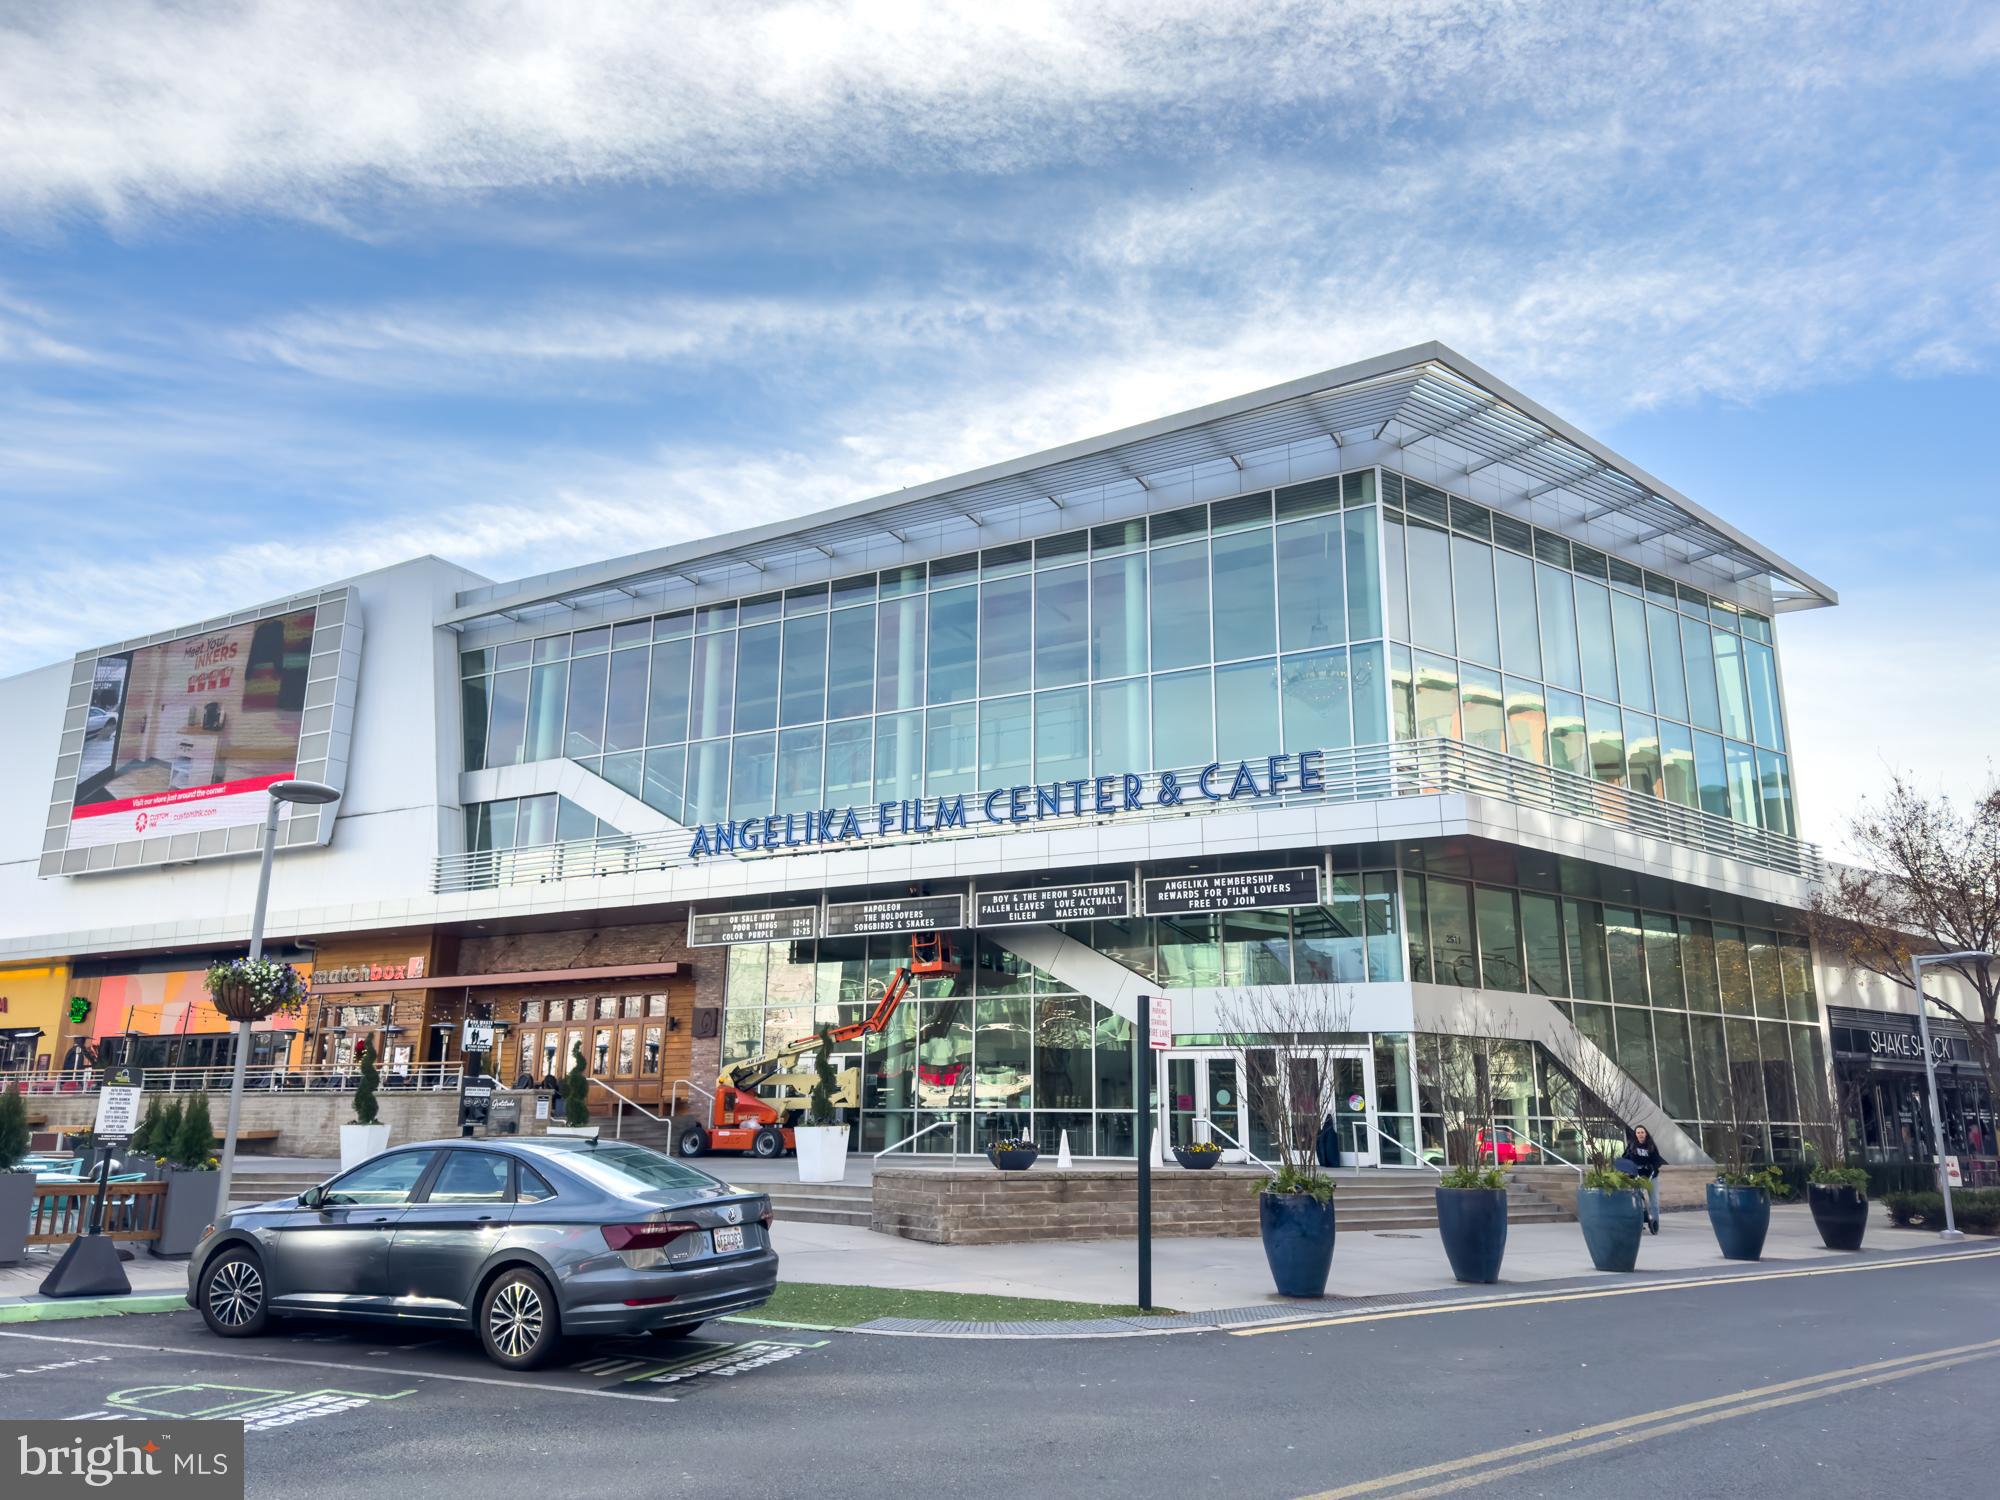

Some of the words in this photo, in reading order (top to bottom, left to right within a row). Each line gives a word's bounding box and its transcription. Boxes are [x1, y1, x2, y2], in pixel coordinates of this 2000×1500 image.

[194, 642, 238, 670] INKERS
[166, 794, 177, 803] just
[177, 790, 196, 799] around
[688, 806, 862, 858] ANGELIKA
[879, 794, 967, 836] FILM
[984, 773, 1142, 824] CENTER
[1157, 771, 1183, 806] &
[1200, 750, 1324, 800] CAFE
[1165, 880, 1209, 891] ANGELIKA
[1214, 874, 1274, 886] MEMBERSHIP
[993, 895, 1008, 904] BOY
[1014, 894, 1018, 902] &
[1023, 892, 1037, 901] THE
[1042, 890, 1068, 900] HERON
[1072, 887, 1116, 898] SALTBURN
[1158, 890, 1199, 900] REWARDS
[1204, 888, 1222, 897] FOR
[1227, 886, 1248, 896] FILM
[1254, 883, 1291, 894] LOVERS
[864, 903, 901, 913] NAPOLEON
[982, 904, 1010, 914] FALLEN
[1014, 902, 1045, 911] LEAVES
[1054, 899, 1075, 908] LOVE
[1080, 896, 1123, 906] ACTUALLY
[1189, 899, 1211, 908] FREE
[1216, 898, 1228, 906] TO
[1233, 896, 1256, 906] JOIN
[741, 914, 758, 922] SALE
[864, 914, 878, 922] THE
[881, 910, 923, 920] HOLDOVERS
[1009, 911, 1037, 920] EILEEN
[1056, 908, 1094, 918] MAESTRO
[732, 923, 750, 931] POOR
[755, 921, 777, 930] THINGS
[793, 919, 810, 927] 12-14
[854, 921, 894, 932] SONGBIRDS
[906, 918, 935, 928] SNAKES
[748, 930, 774, 939] PURPLE
[793, 927, 810, 936] 12-25
[312, 963, 407, 984] matchbox
[1870, 1031, 1910, 1055] SHAKE
[244, 1400, 370, 1432] ICKUP
